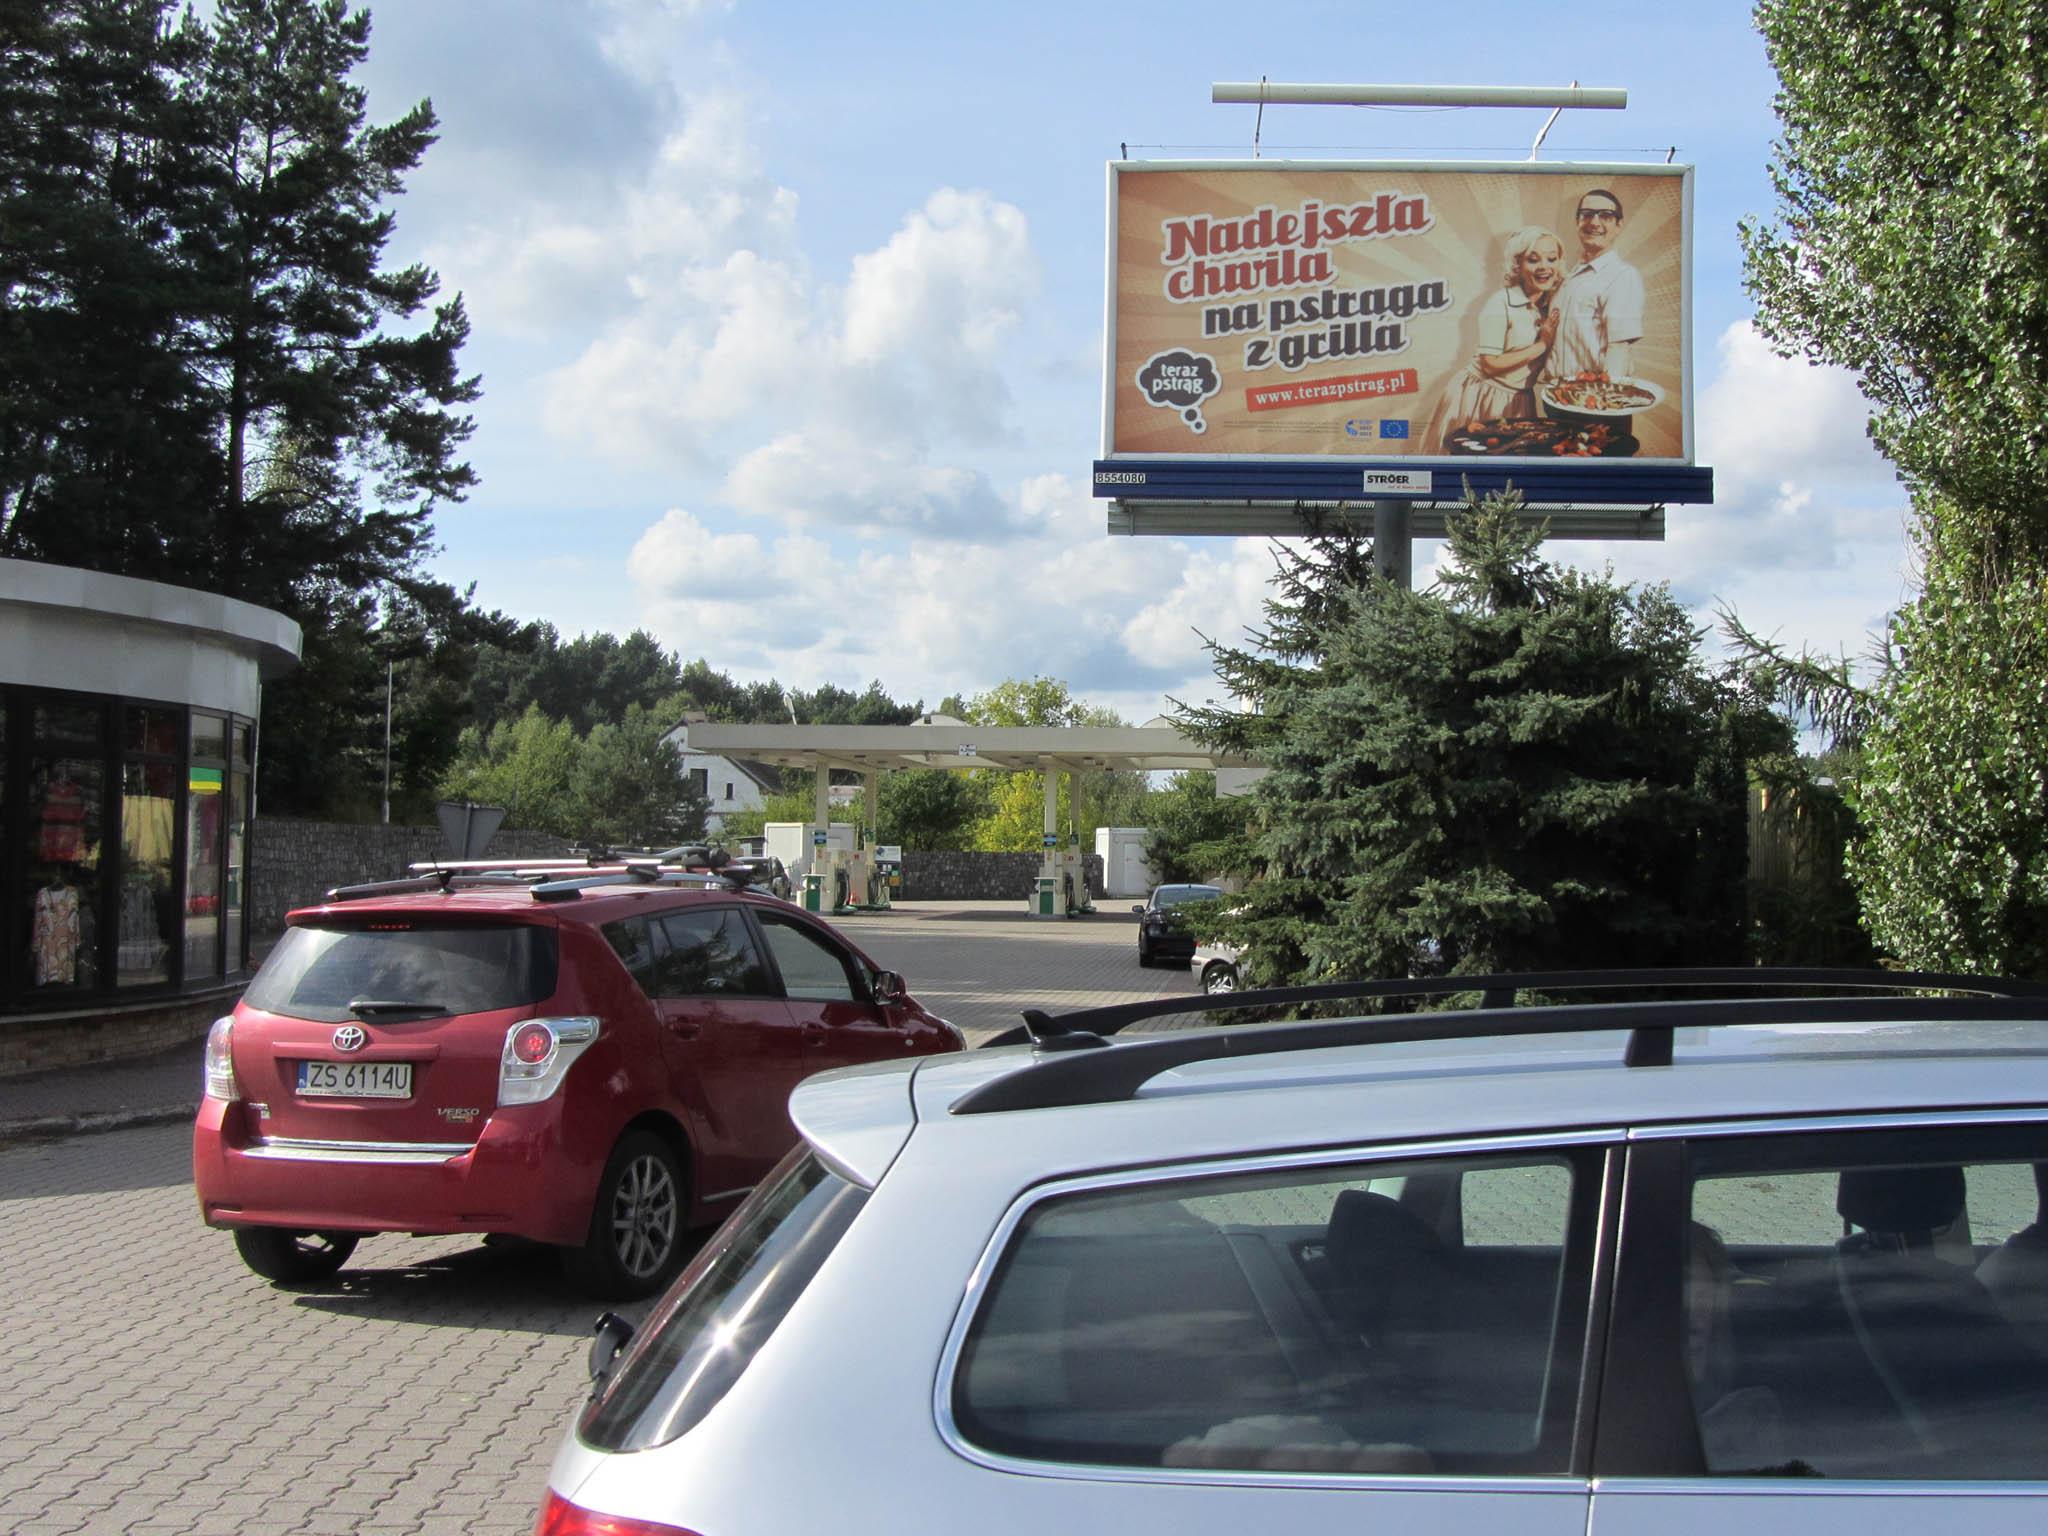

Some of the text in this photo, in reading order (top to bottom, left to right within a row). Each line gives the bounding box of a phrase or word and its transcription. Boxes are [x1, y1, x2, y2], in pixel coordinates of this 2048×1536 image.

[1165, 194, 1431, 261] Nadejszła
[1167, 249, 1334, 300] chwila
[1205, 303, 1264, 335] na
[1247, 340, 1273, 367] z
[1161, 364, 1200, 377] teraz
[1152, 377, 1204, 395] pstrąg
[1255, 372, 1406, 405] www.terazpstrag.pl
[1096, 472, 1146, 484] 8554080
[310, 1064, 408, 1089] ZS 6114U
[437, 1107, 480, 1116] VERSO
